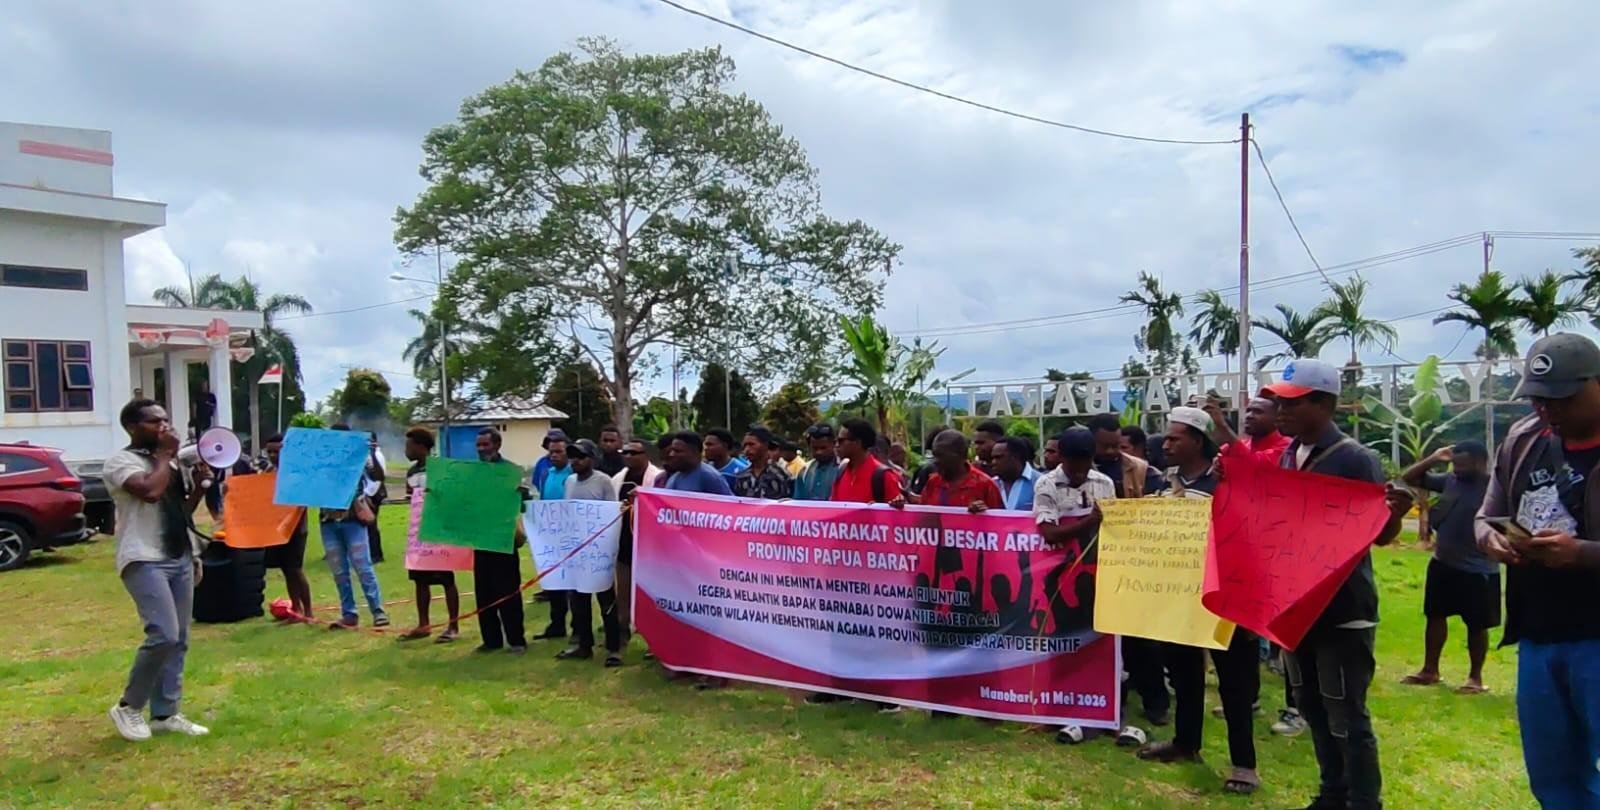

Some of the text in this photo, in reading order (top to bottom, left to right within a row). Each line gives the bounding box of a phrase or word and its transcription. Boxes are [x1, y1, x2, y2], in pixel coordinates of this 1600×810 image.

[657, 508, 1064, 552] SOLIDARITAS PEMUDA MASYARAKAT SUKU BESAR ARFA
[748, 541, 918, 572] PROVINSI PAPUA BARAT
[698, 584, 1000, 628] SEGERA MELANTIK BAPAK BARNABAS DOWANSIBA SEBAGAI
[720, 568, 970, 606] DENGAN INI MEMINTA MENTERI AGAMA RI UNTUK
[686, 602, 723, 618] KANTOR
[724, 608, 770, 625] WILAYAH
[771, 613, 834, 633] KEMENTRIAN
[836, 622, 877, 639] AGAMA
[1015, 636, 1081, 653] DEFENITIF
[1040, 691, 1049, 704] 11
[1053, 690, 1075, 705] Mei
[1077, 693, 1107, 707] 2026
